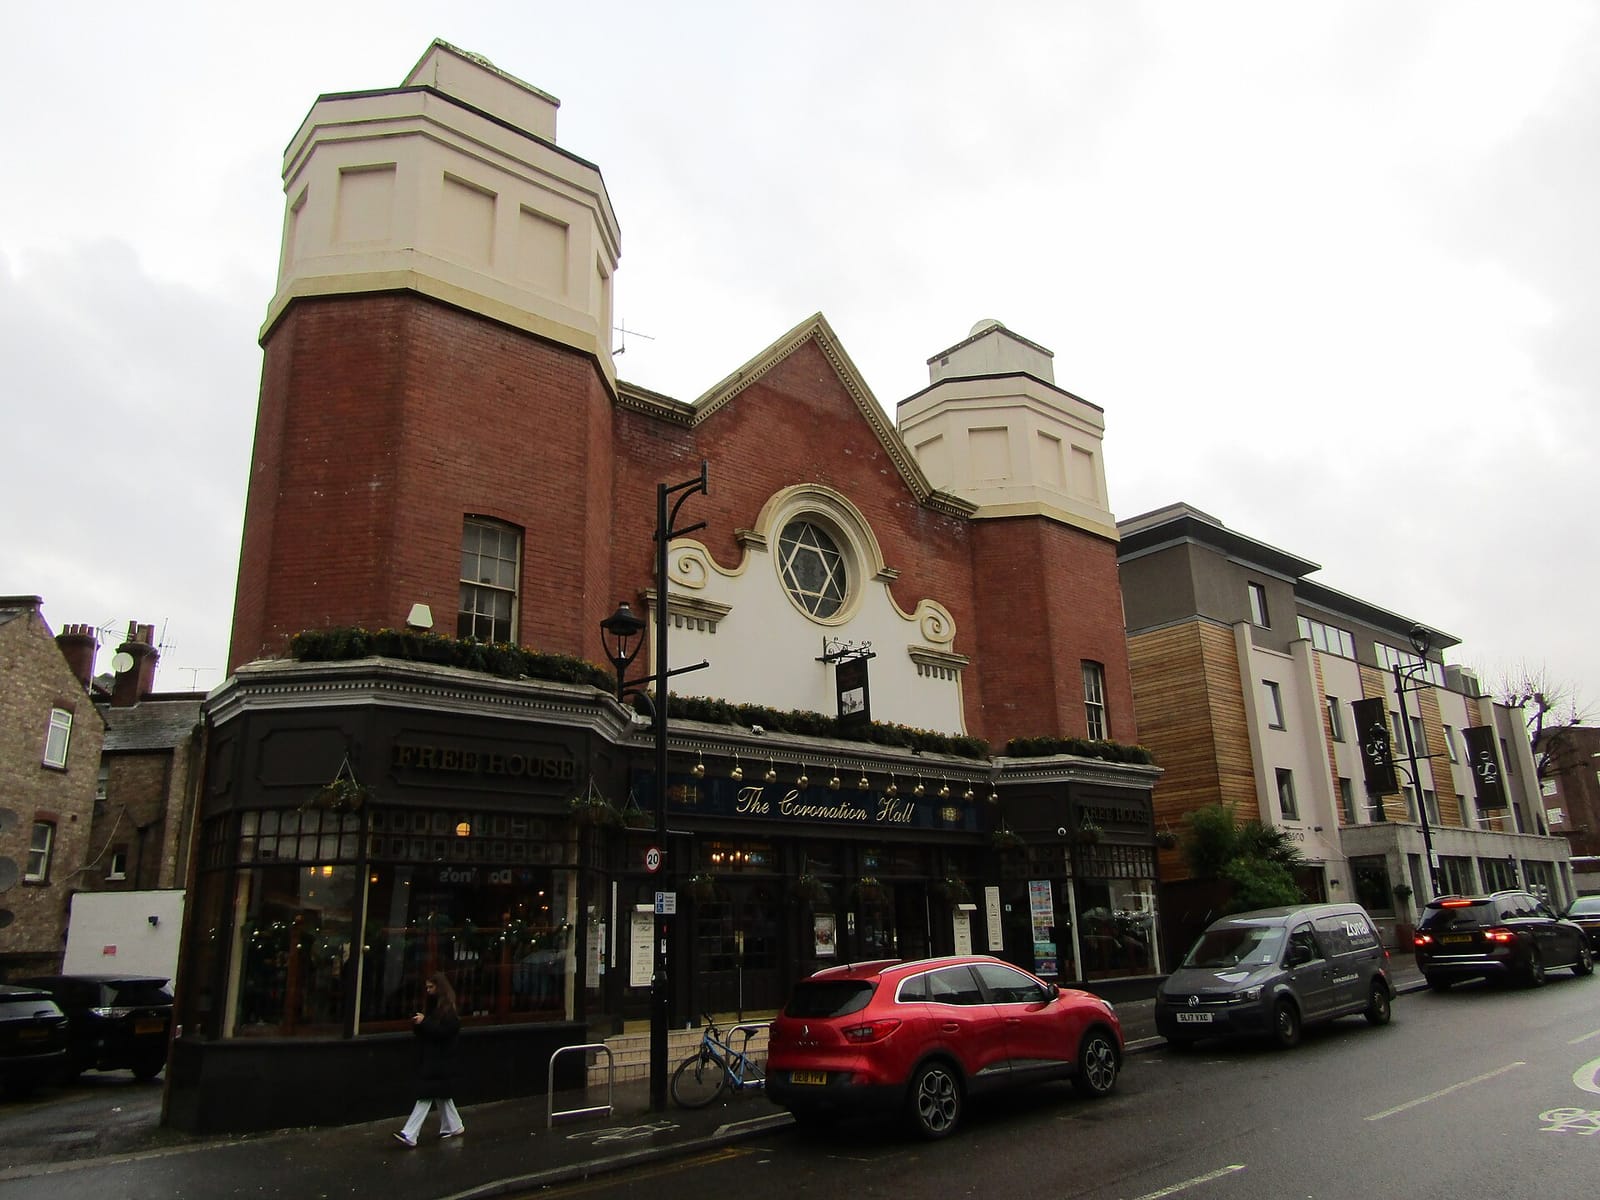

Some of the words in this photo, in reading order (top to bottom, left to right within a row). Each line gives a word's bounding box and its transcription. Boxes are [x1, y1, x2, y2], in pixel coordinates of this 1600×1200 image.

[391, 744, 479, 774] FREE
[484, 751, 576, 780] HOUSE
[736, 786, 770, 814] The
[778, 789, 868, 820] Coronation
[875, 796, 916, 823] Hall
[648, 854, 659, 865] 20
[1341, 919, 1370, 936] Zonal
